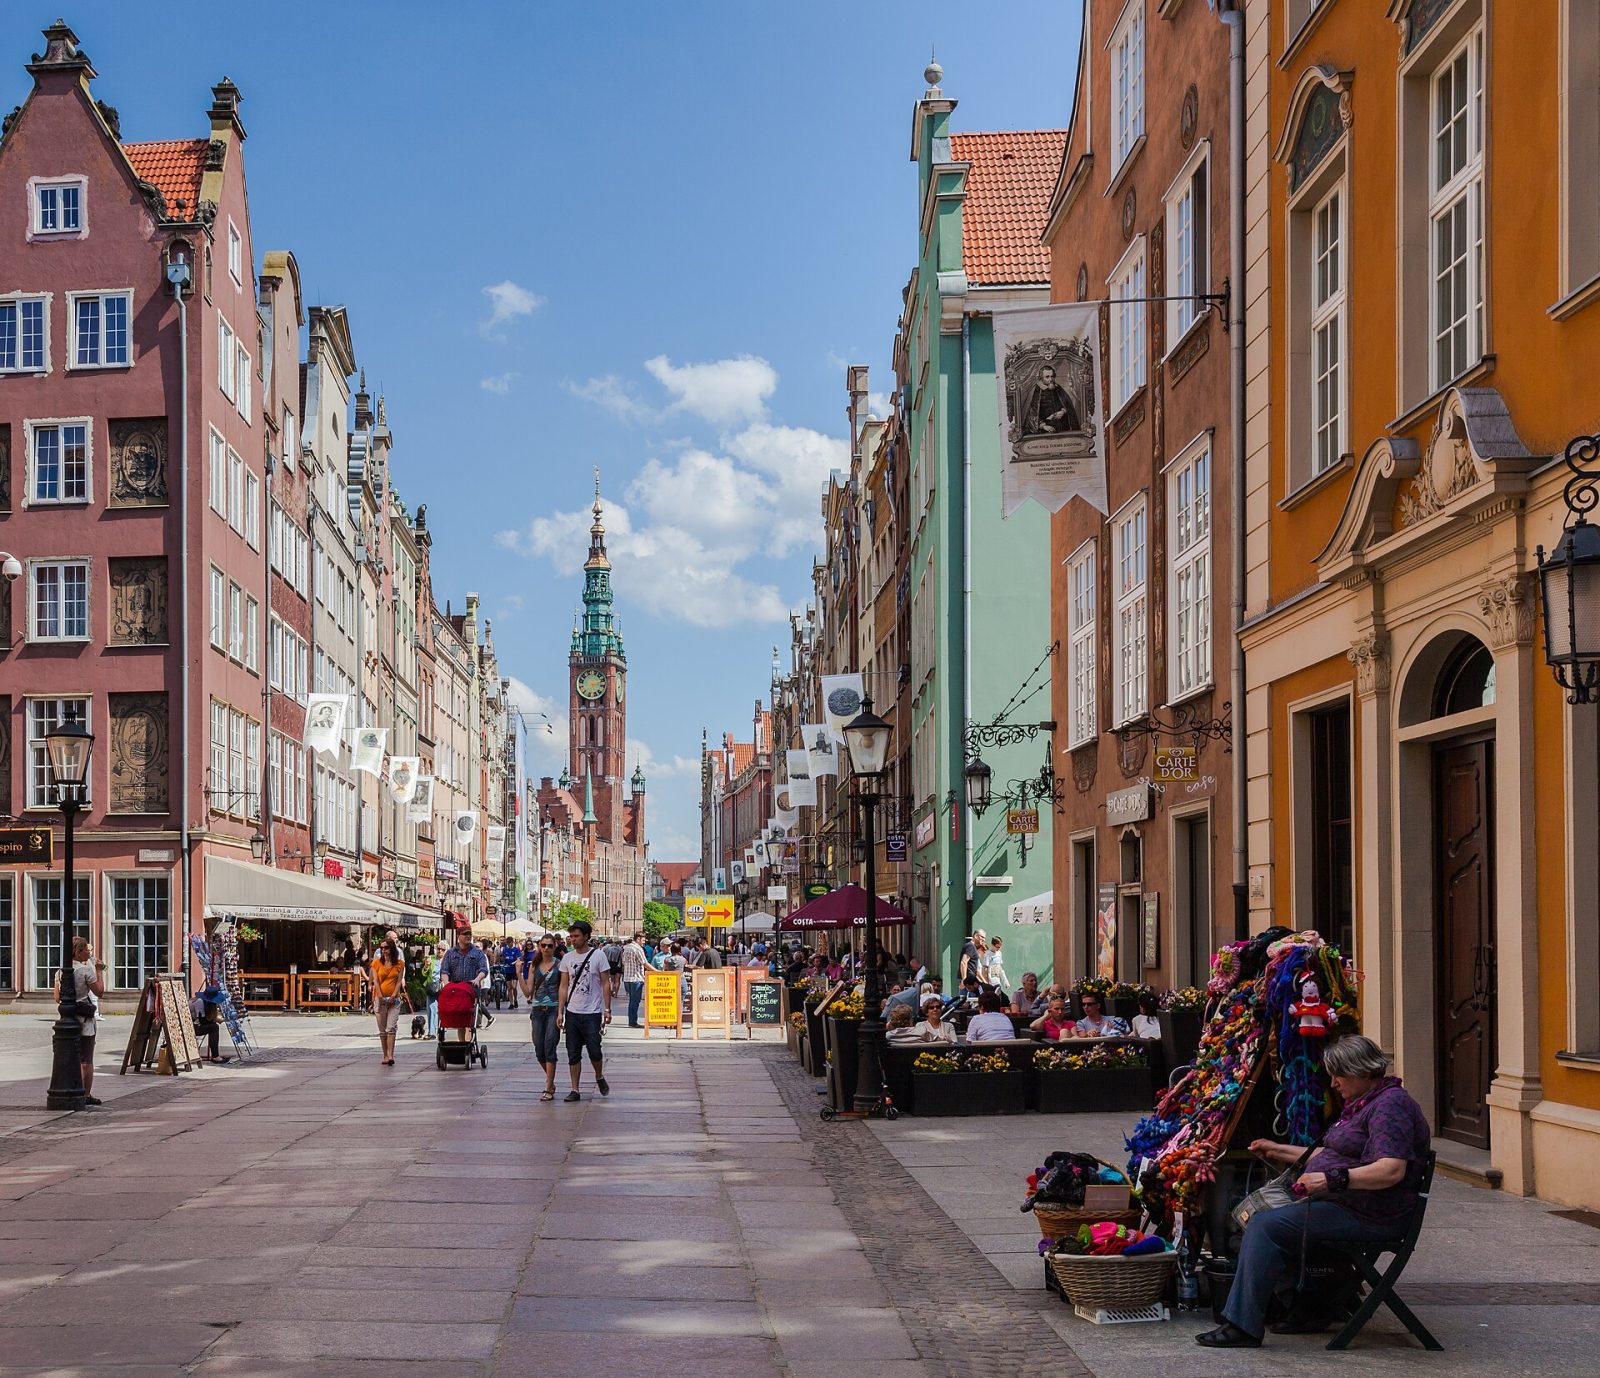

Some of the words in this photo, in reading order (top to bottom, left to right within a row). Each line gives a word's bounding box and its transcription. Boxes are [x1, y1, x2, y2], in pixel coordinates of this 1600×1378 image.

[1156, 756, 1196, 768] CARTE
[1009, 815, 1037, 825] CARTE
[793, 918, 813, 926] COSTA
